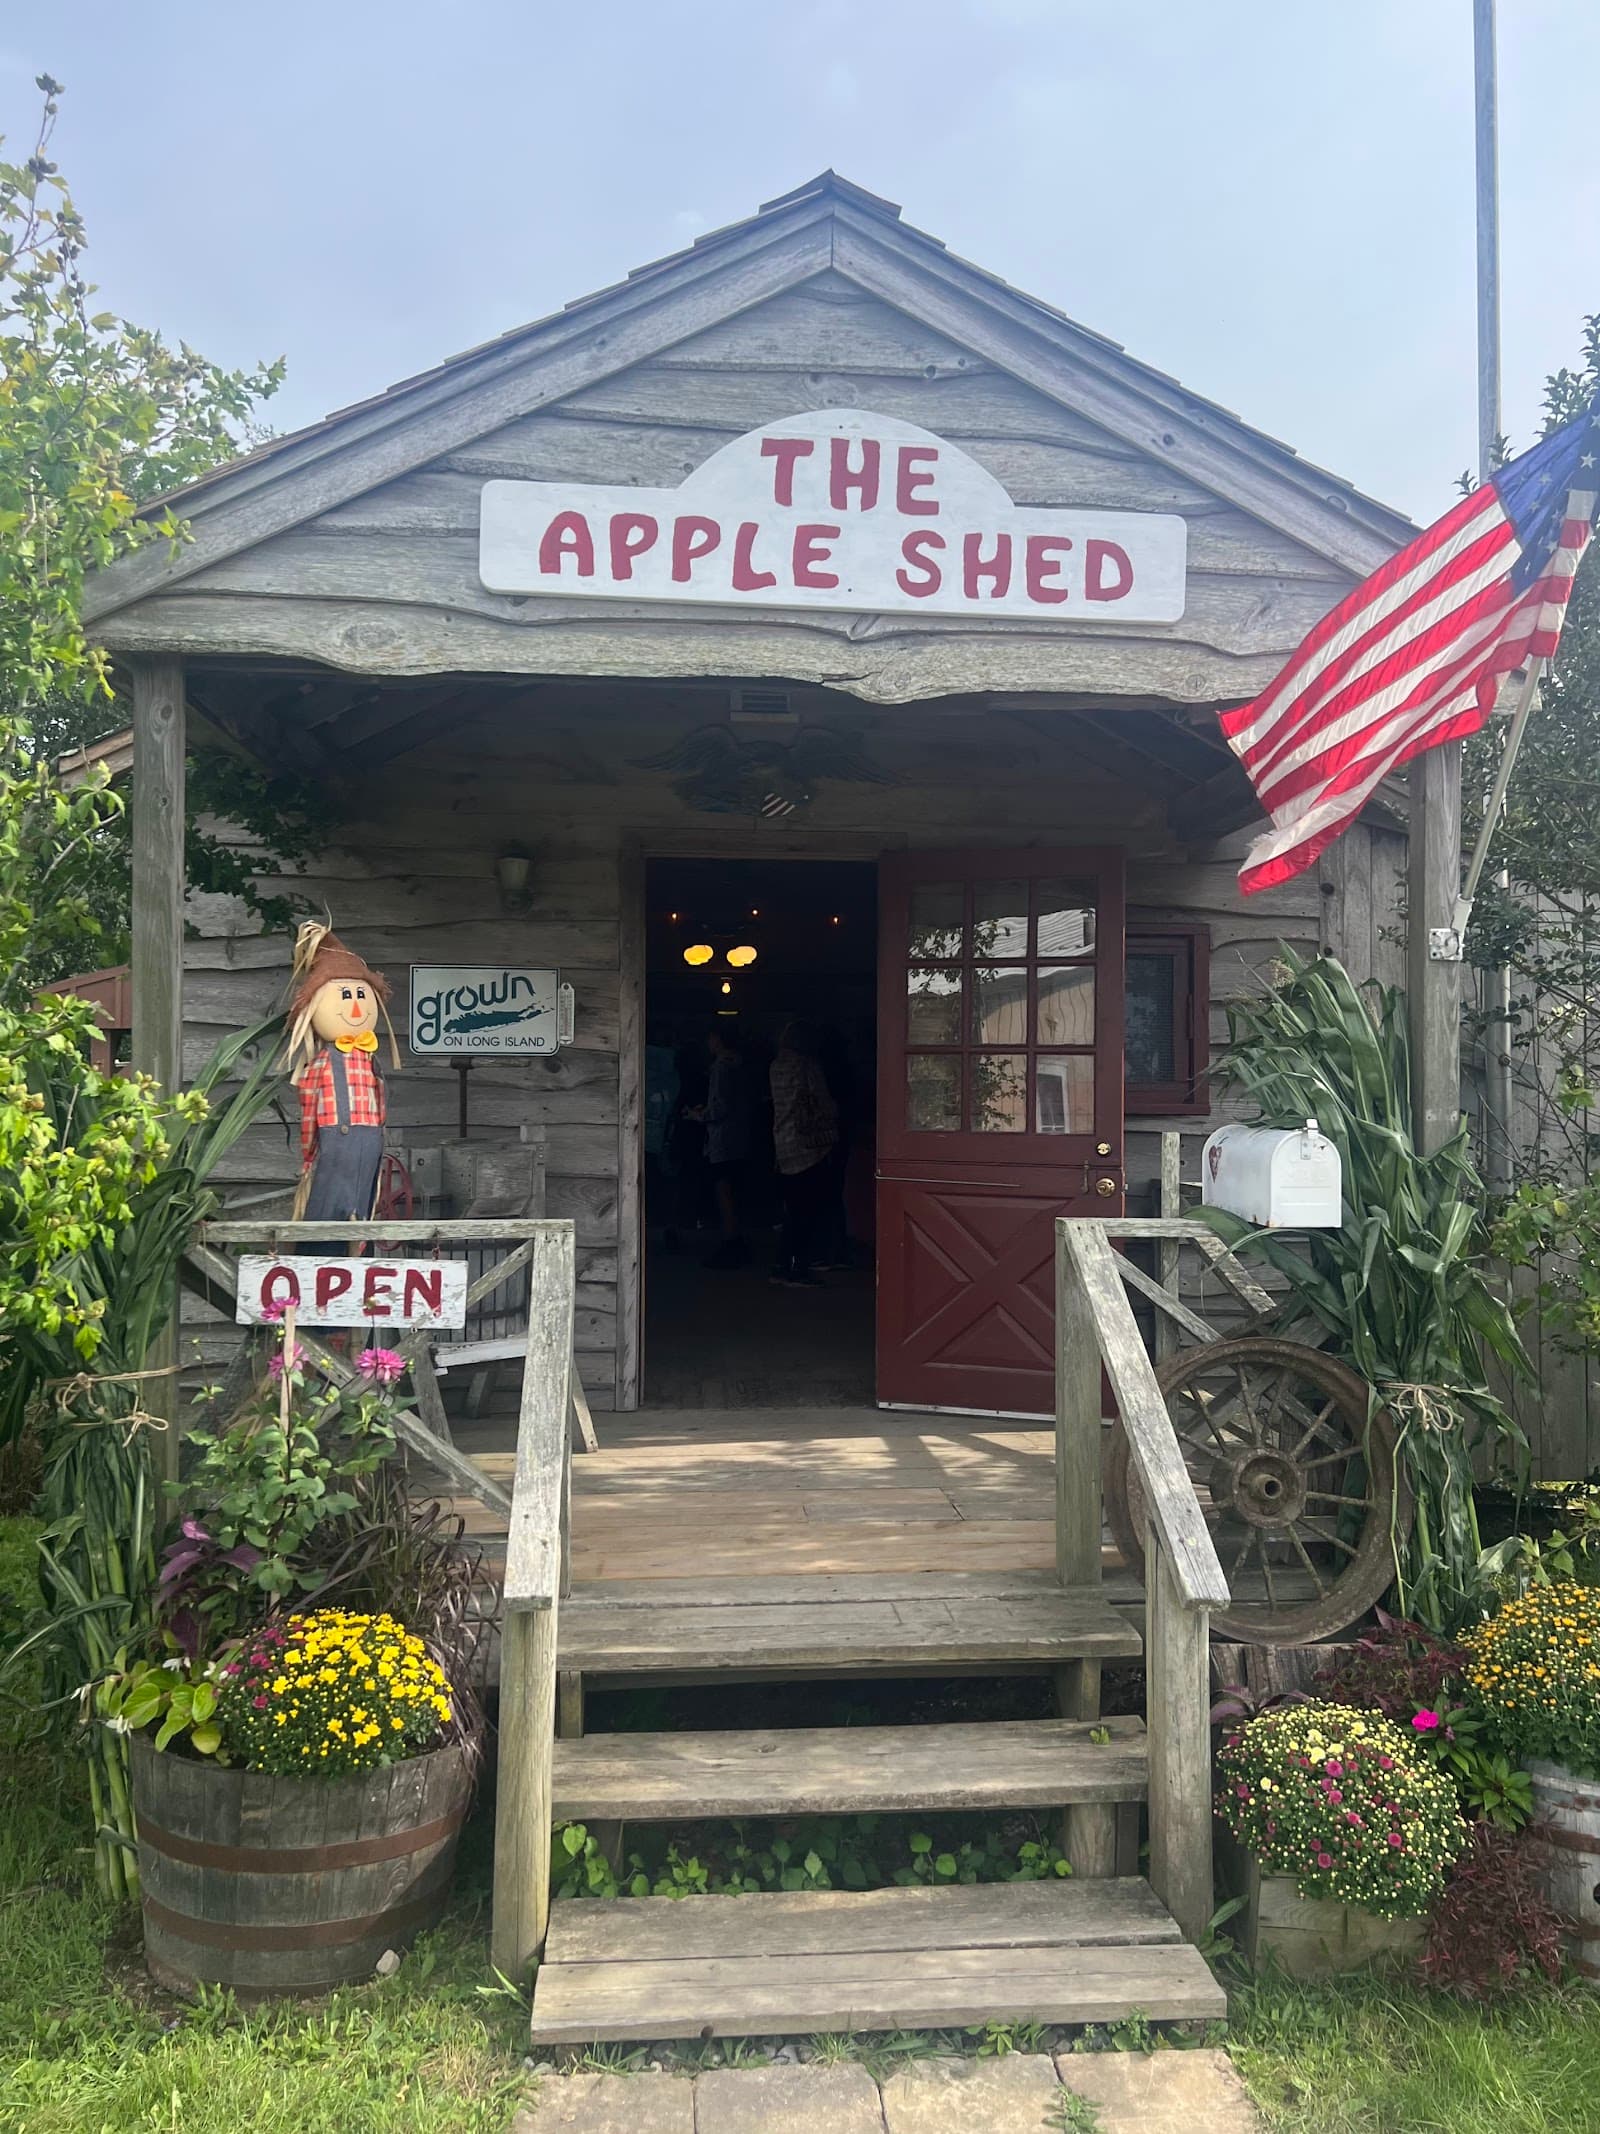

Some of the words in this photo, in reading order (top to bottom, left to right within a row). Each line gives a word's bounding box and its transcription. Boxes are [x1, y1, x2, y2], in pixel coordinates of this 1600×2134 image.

[760, 437, 939, 515] THE
[539, 510, 841, 590] APPLE
[895, 530, 1133, 604] SHED
[416, 971, 537, 1045] grown
[443, 1036, 463, 1047] ON
[467, 1036, 500, 1047] LONG
[504, 1036, 545, 1047] ISLAND
[260, 1265, 442, 1319] OPEN
